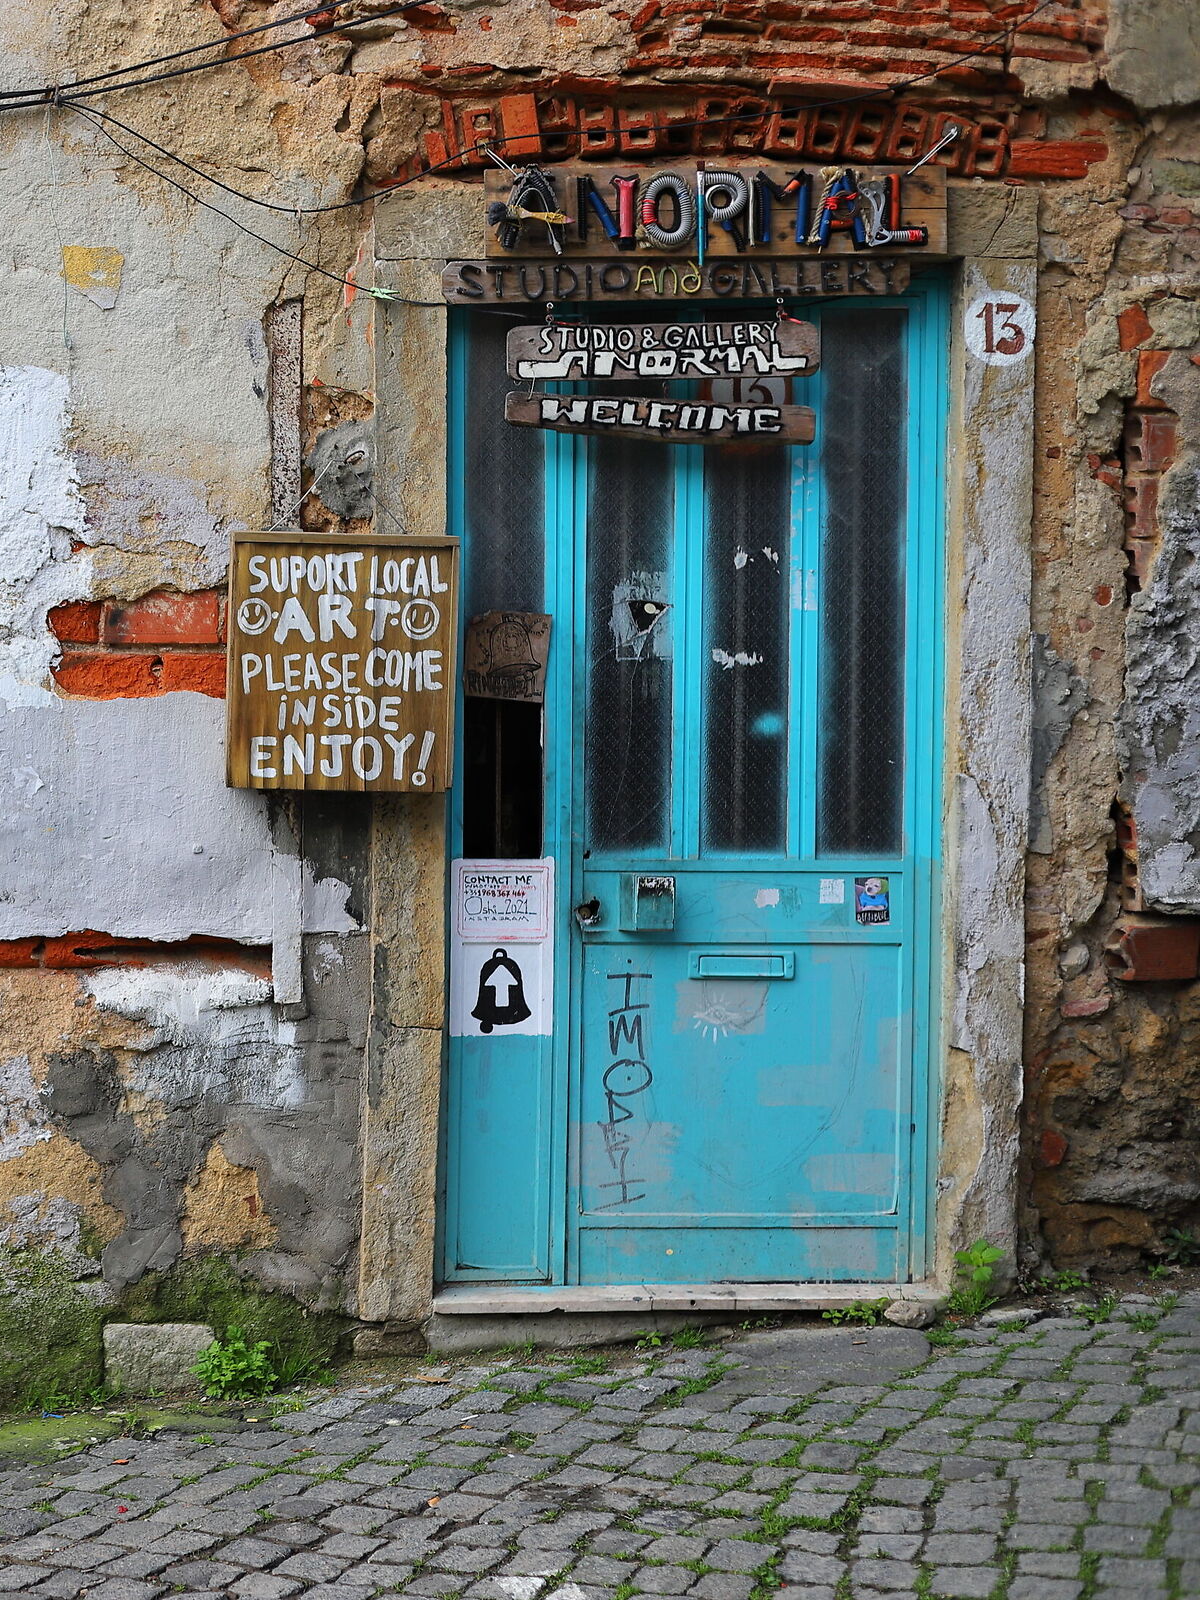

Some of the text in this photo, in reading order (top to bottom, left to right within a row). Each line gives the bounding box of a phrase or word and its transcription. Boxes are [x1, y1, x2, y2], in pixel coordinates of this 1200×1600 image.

[456, 263, 632, 299] STUDIO
[708, 259, 900, 297] GALLERY
[540, 322, 779, 354] STUDIO & GALLERY
[976, 302, 1026, 355] 13
[517, 344, 807, 378] ANORMAL
[541, 399, 782, 432] WELCOME
[248, 552, 448, 597] SUPORT LOCAL
[241, 647, 443, 694] PLEASE COME
[250, 730, 436, 786] ENJOY!
[464, 875, 532, 885] CONTACT ME
